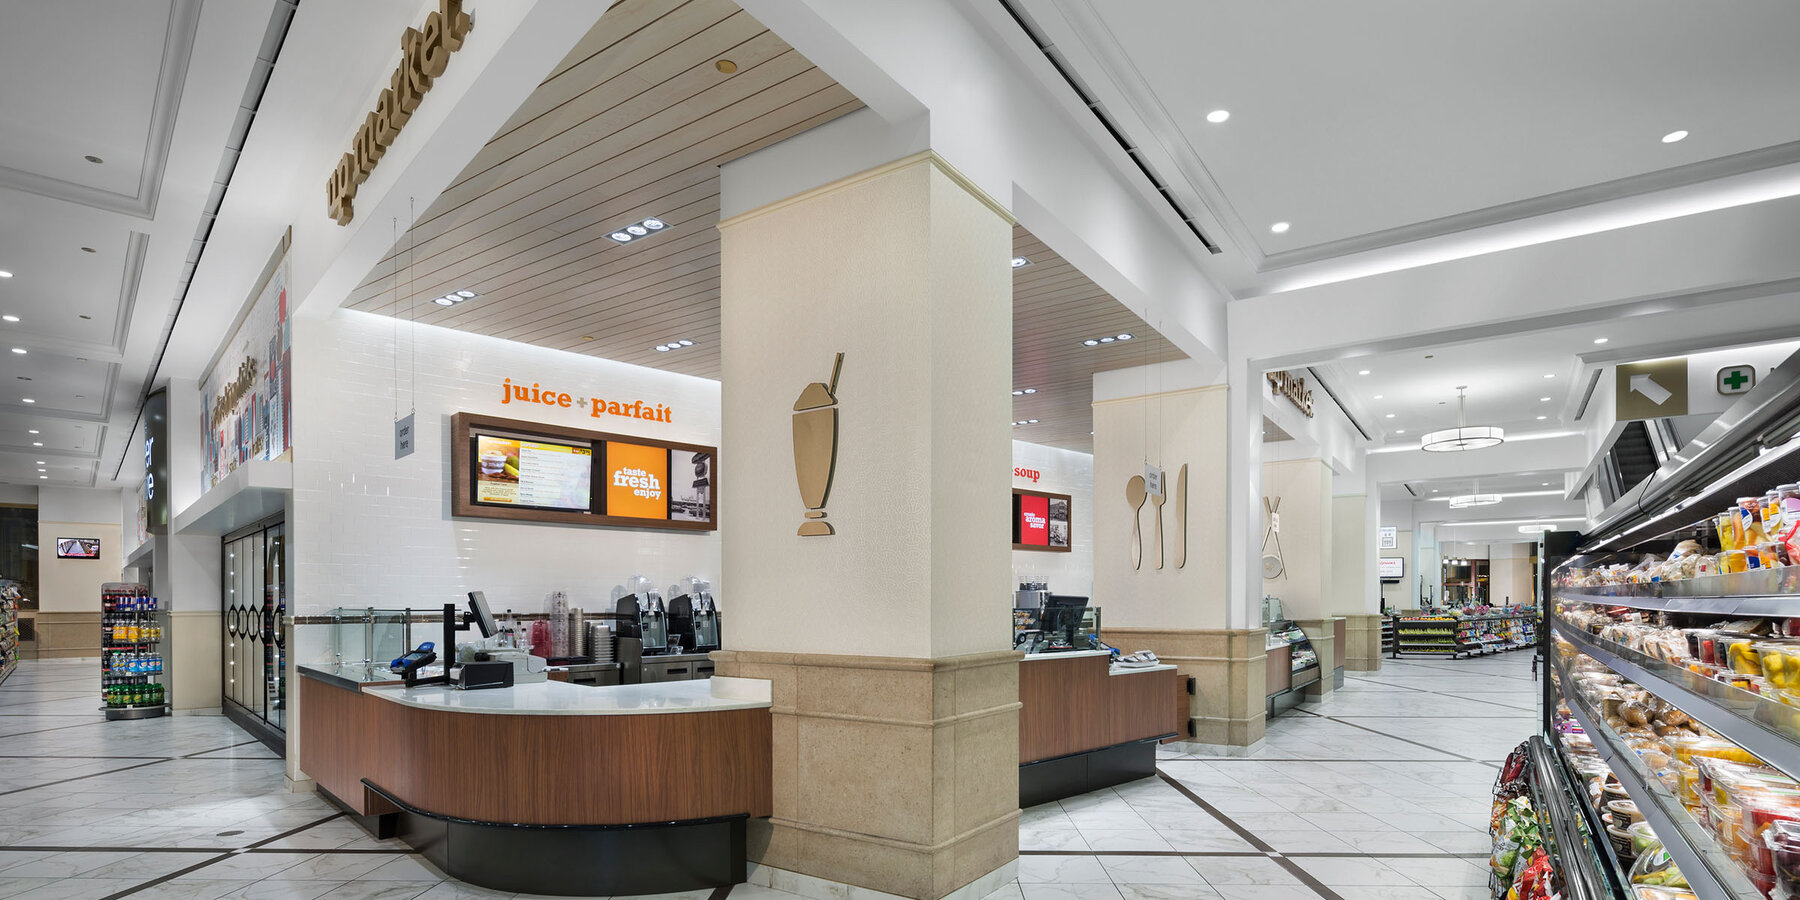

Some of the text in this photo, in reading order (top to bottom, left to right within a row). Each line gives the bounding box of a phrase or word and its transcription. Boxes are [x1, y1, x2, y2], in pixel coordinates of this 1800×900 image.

[326, 152, 357, 227] up
[502, 378, 572, 407] juice
[591, 397, 672, 423] parfait
[613, 470, 661, 490] fresh
[622, 467, 647, 477] taste
[1013, 467, 1040, 483] soup
[633, 488, 662, 500] enjoy
